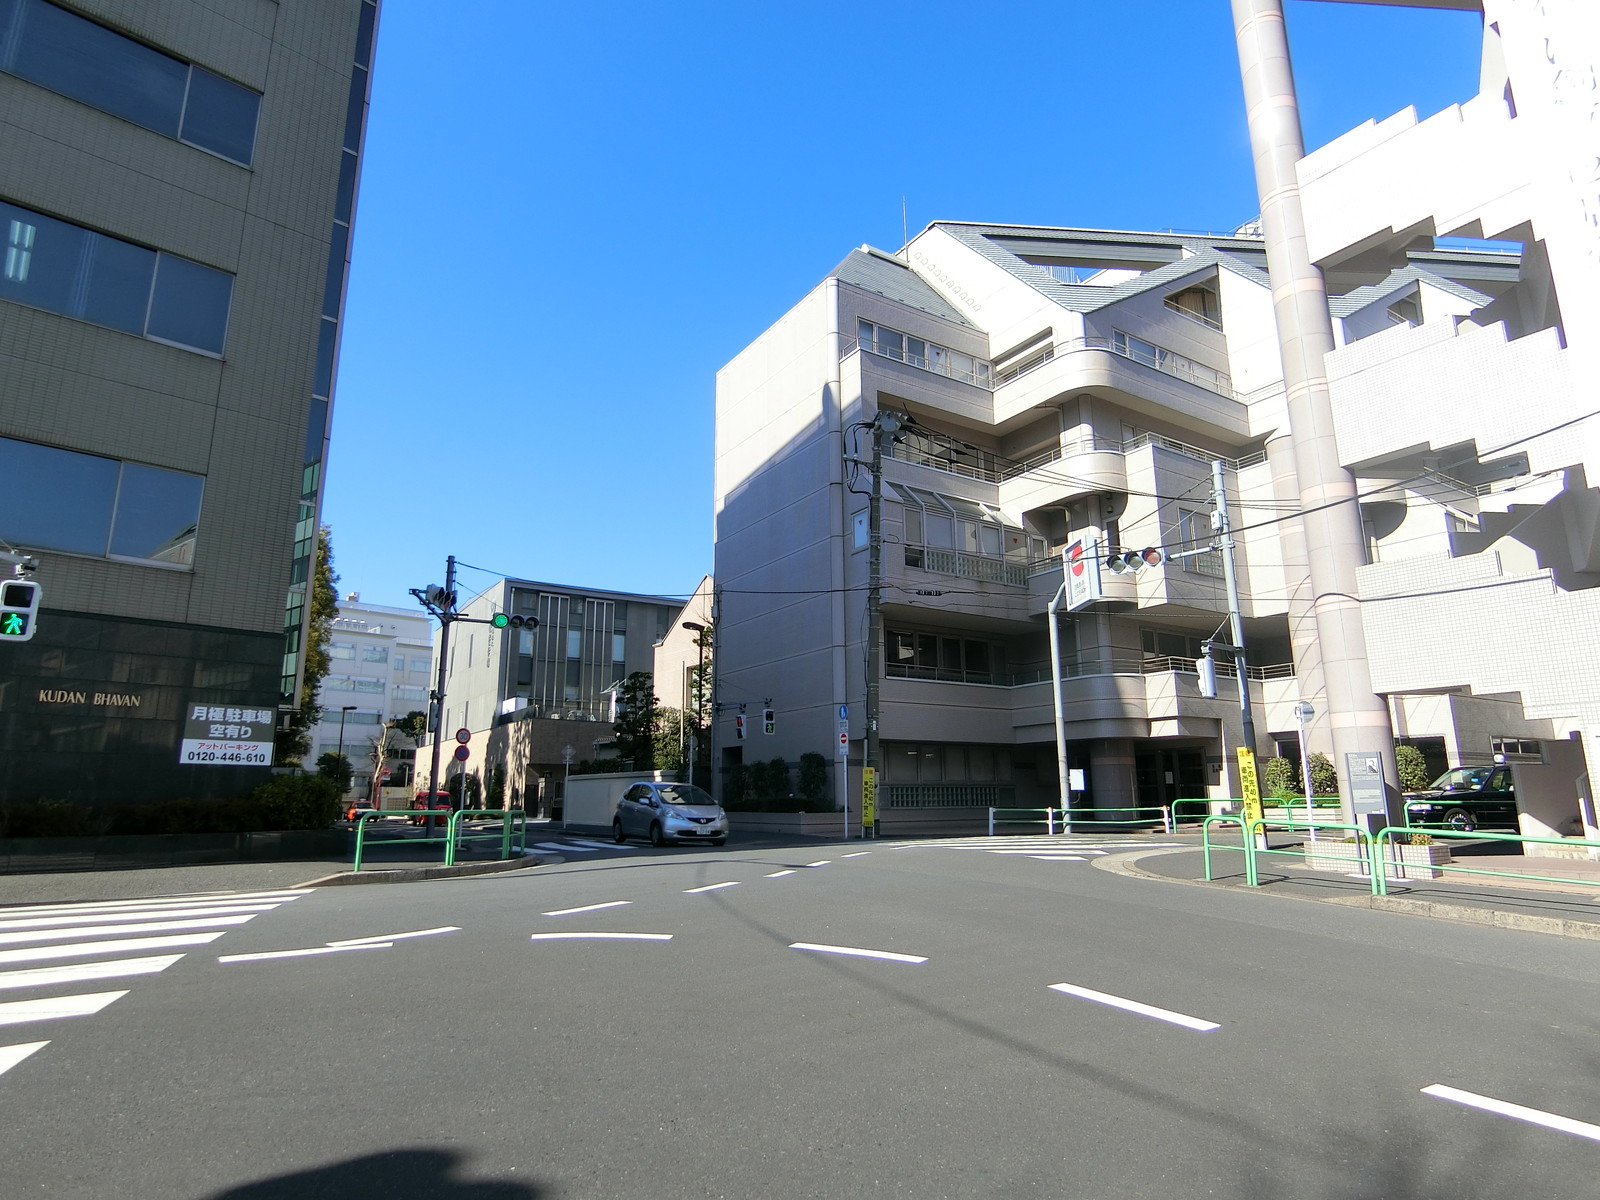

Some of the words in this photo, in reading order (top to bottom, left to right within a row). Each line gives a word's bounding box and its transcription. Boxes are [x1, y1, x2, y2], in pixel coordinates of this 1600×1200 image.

[39, 689, 86, 704] KUDAN
[93, 692, 141, 707] BHAVAN
[191, 706, 273, 724] 月極駐車場
[208, 724, 252, 738] 空有り
[198, 742, 259, 752] アットパーキング
[187, 751, 266, 763] 0120-446-610
